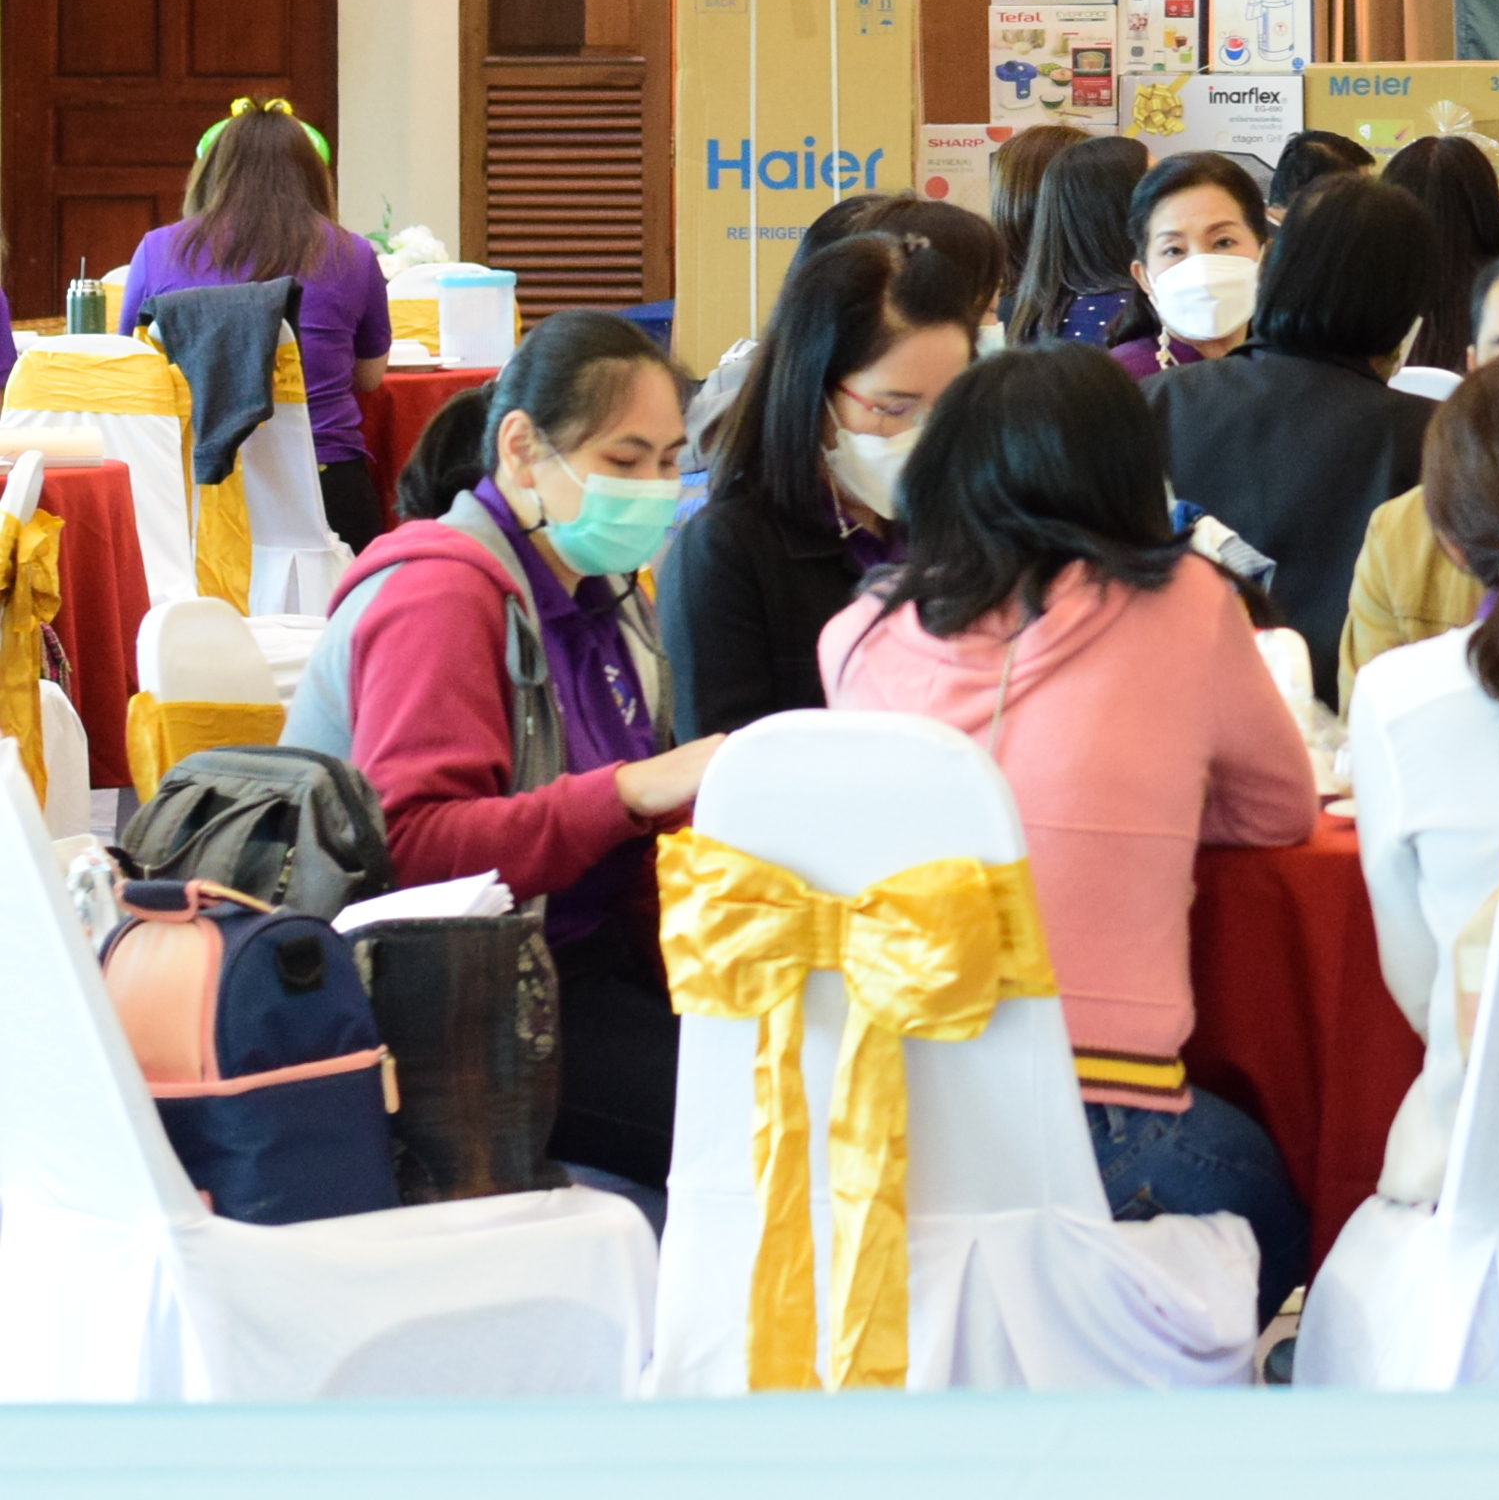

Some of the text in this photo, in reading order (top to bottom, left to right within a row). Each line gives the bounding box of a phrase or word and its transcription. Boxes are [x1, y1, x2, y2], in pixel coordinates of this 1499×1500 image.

[997, 11, 1043, 23] Tefal
[1208, 85, 1281, 104] imarflex
[1328, 75, 1412, 97] Meier
[928, 138, 985, 148] SHARP
[706, 135, 885, 190] Haier
